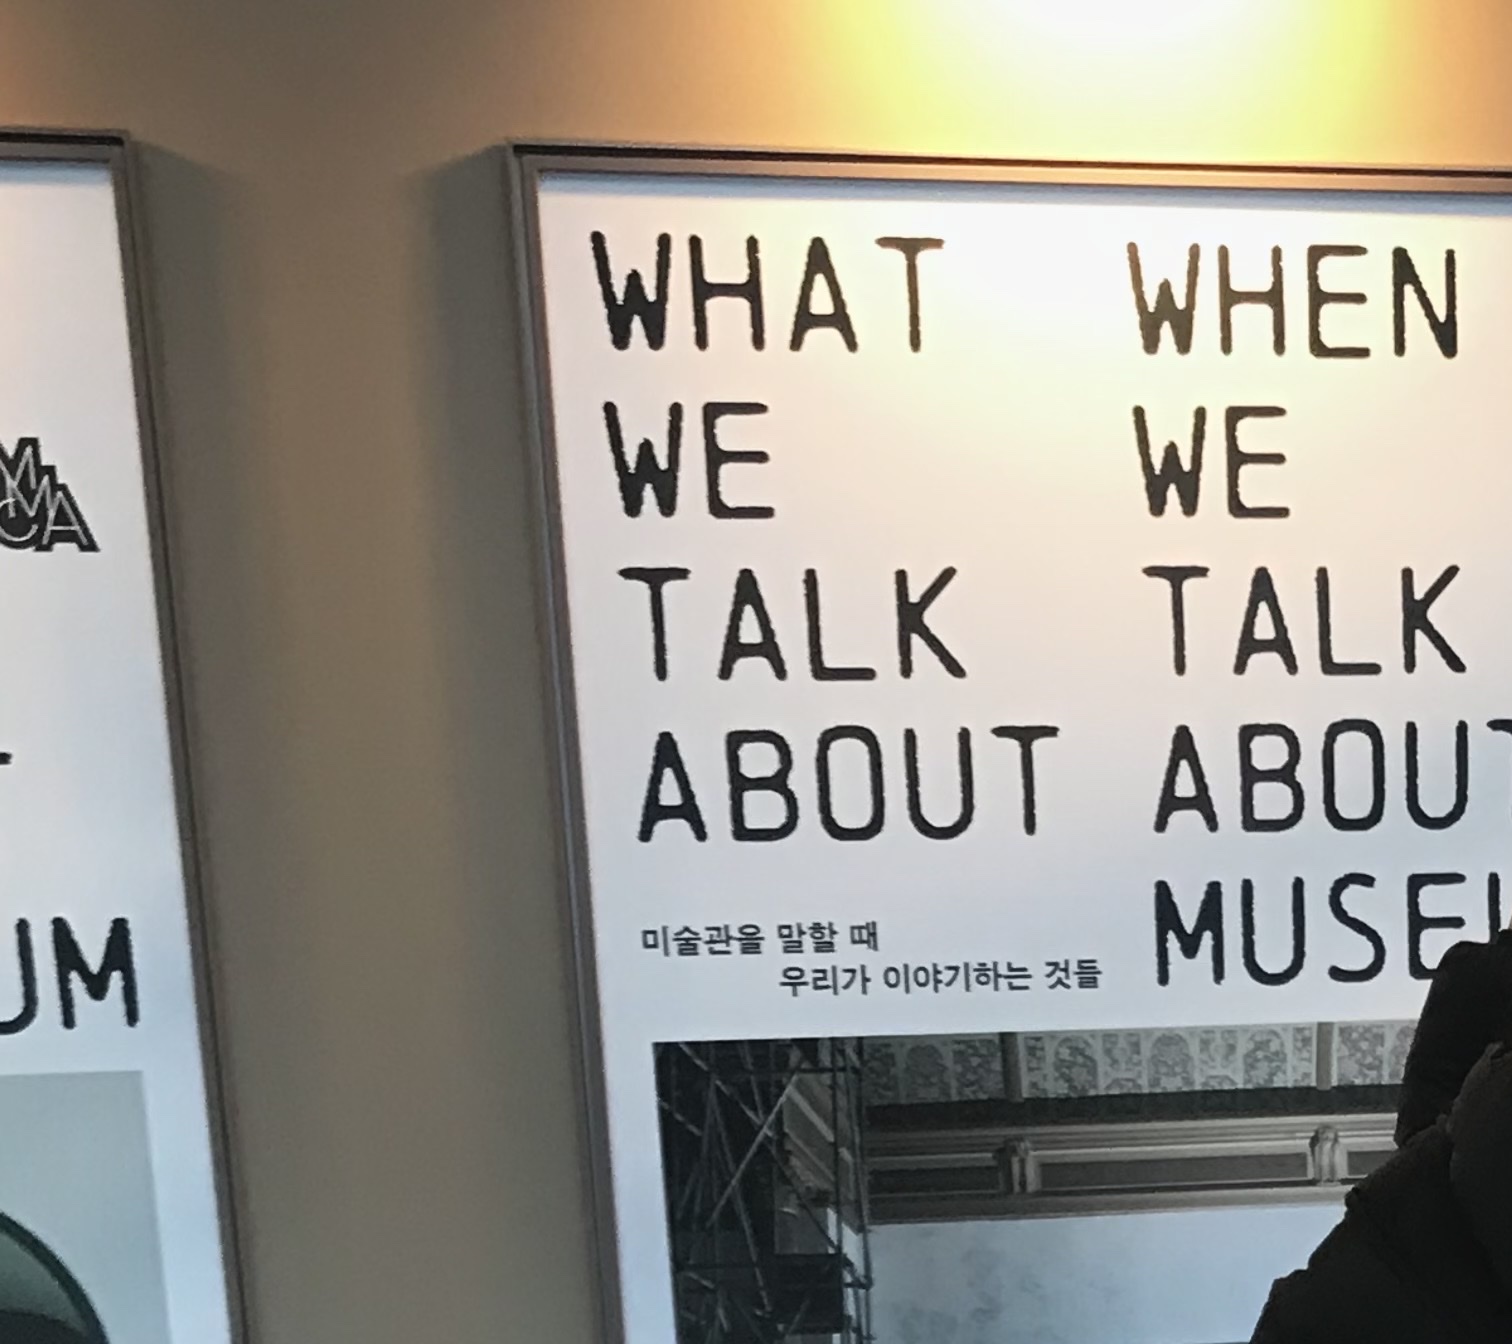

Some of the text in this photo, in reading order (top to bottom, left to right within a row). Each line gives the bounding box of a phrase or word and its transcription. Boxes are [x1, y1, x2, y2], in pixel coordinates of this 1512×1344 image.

[590, 231, 944, 353] WHAT
[1127, 242, 1458, 359] WHEN
[602, 401, 775, 519] WE
[1133, 405, 1290, 519] WE
[617, 566, 966, 681] TALK
[1142, 565, 1467, 676] TALK
[637, 725, 1059, 843] ABOUT
[642, 921, 878, 957] 미술관을 말할 때
[779, 959, 1102, 997] 우리가 이야기하는 것들
[1154, 871, 1500, 985] MUSE
